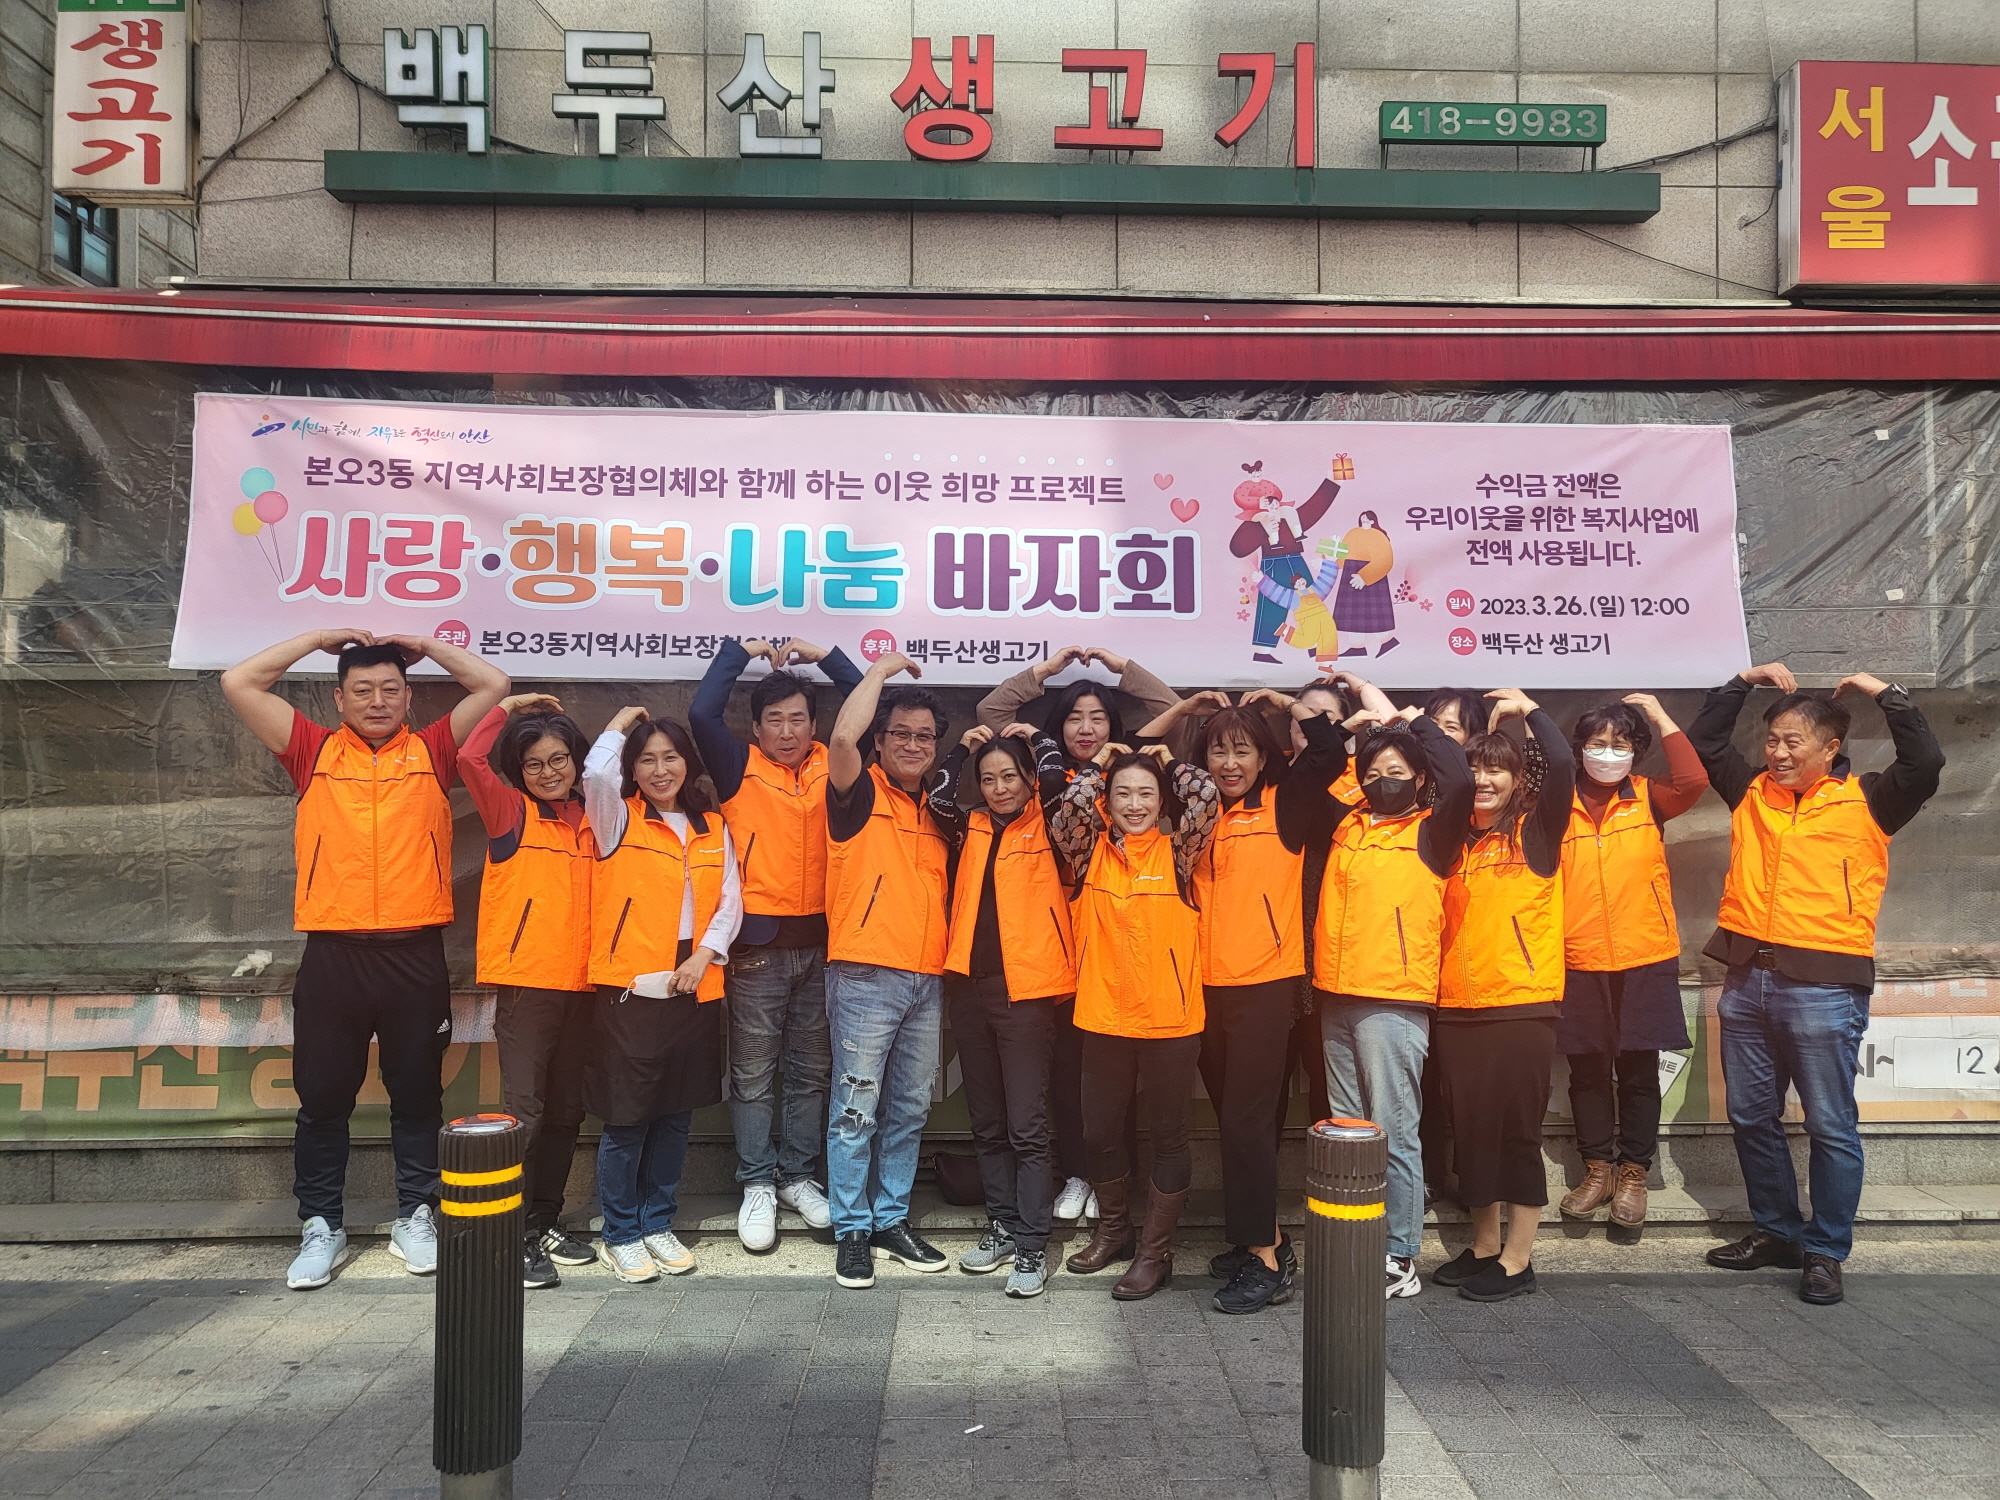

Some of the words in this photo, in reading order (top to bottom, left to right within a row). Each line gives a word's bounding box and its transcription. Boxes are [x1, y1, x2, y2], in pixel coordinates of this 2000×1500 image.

[66, 19, 172, 185] 생고기
[1389, 105, 1599, 138] 418-9983
[1907, 94, 2000, 206] 소
[1818, 86, 1892, 250] 서울
[458, 428, 494, 444] 안산
[303, 456, 415, 490] 본오3동
[423, 461, 728, 498] 지역사회보장협의체와
[737, 467, 796, 500] 함께
[805, 469, 865, 501] 하는
[874, 471, 932, 502] 이웃
[941, 472, 1000, 503] 희망
[1008, 475, 1126, 506] 프로젝트
[1475, 473, 1548, 499] 수익금
[1552, 472, 1622, 499] 전액은
[1405, 505, 1526, 532] 우리이웃을
[1529, 505, 1577, 533] 위한
[1580, 506, 1700, 534] 복지사업에
[1465, 539, 1513, 566] 전액
[1518, 539, 1642, 567] 사용됩니다.
[933, 532, 1196, 614] 바자회
[1449, 597, 1471, 610] 일시
[1630, 597, 1690, 616] 12:00
[437, 630, 467, 646] 주관
[864, 639, 892, 654] 후원
[906, 638, 1048, 664] 백두산생고기
[1451, 635, 1474, 648] 장소
[1481, 633, 1543, 655] 백두산
[1549, 632, 1610, 655] 생고기
